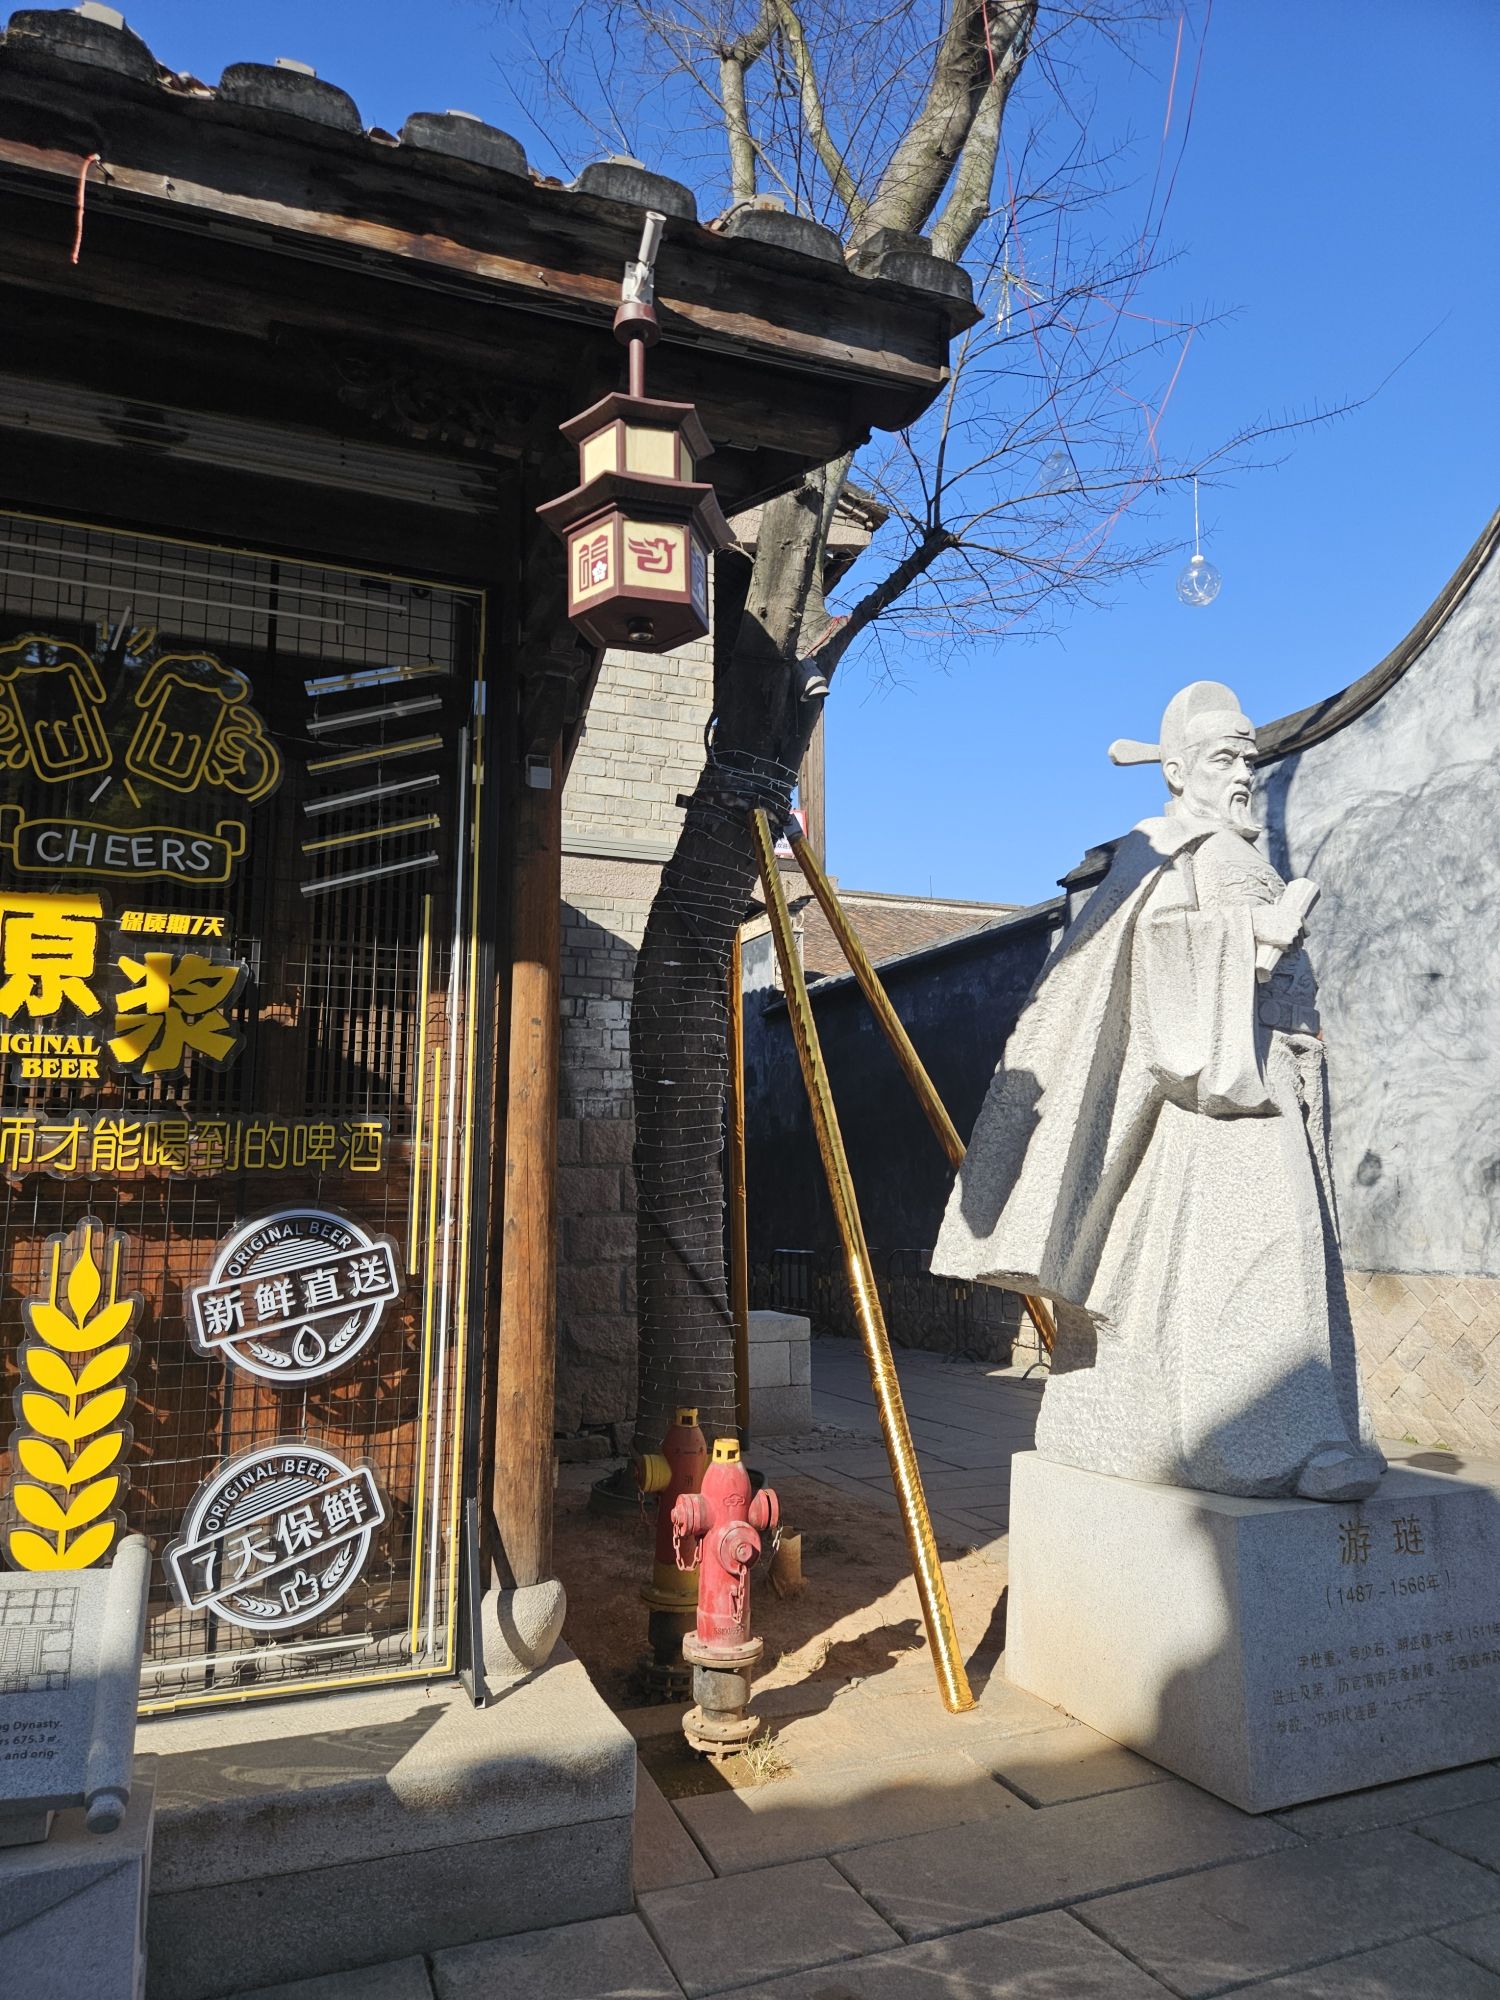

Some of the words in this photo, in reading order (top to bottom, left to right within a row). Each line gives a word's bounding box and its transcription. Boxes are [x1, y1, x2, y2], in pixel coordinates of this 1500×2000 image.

[36, 828, 213, 872] CHEERS
[119, 910, 225, 937] 保质期7天
[21, 1058, 100, 1078] BEER
[227, 1225, 304, 1277] ORIGINAL
[309, 1221, 352, 1250] BEER
[203, 1254, 390, 1335] 新鲜直送
[205, 1463, 278, 1531] ORIGINAL
[284, 1459, 330, 1482] BEER
[191, 1483, 368, 1591] 7天保鲜
[1337, 1513, 1425, 1565] 游琏
[5, 1750, 28, 1760] and
